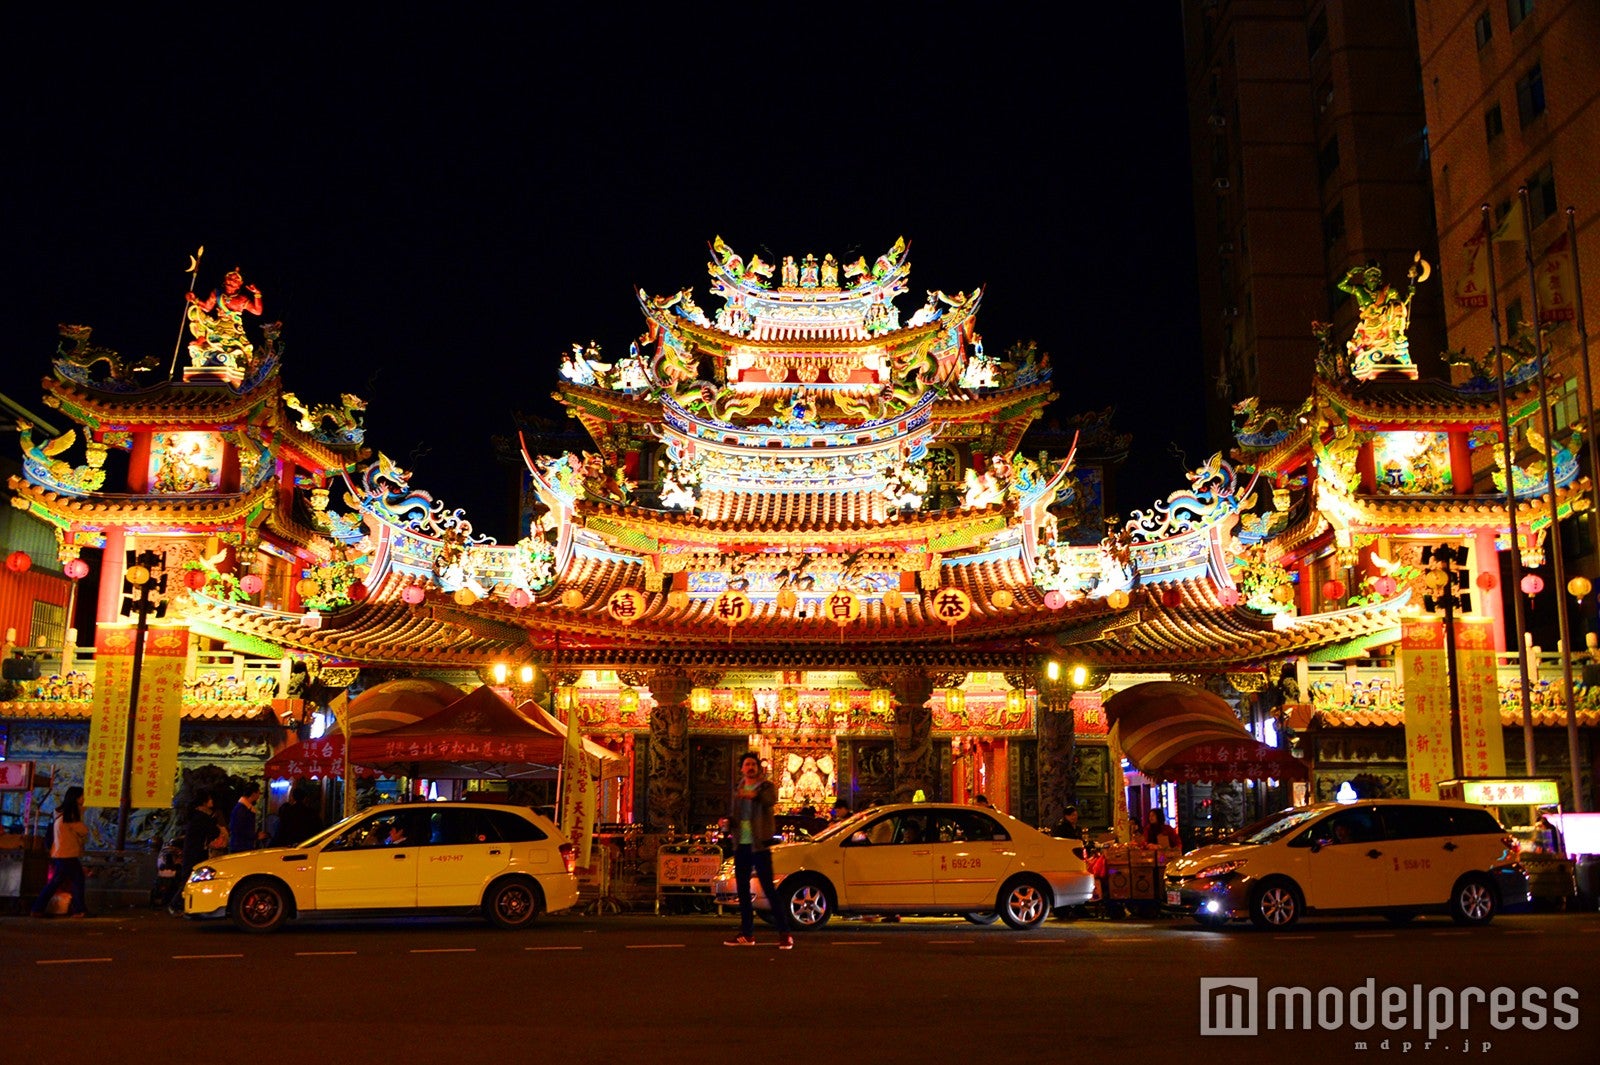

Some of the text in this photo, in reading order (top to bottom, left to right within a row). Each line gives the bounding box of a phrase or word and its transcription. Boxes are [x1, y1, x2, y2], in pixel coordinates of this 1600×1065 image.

[610, 594, 638, 618] 禧
[717, 596, 745, 619] 新
[829, 596, 853, 619] 賀
[938, 595, 965, 618] 恭
[1413, 655, 1433, 794] 恭賀新禧
[1217, 745, 1267, 762] 台北市
[951, 858, 982, 869] 692-28
